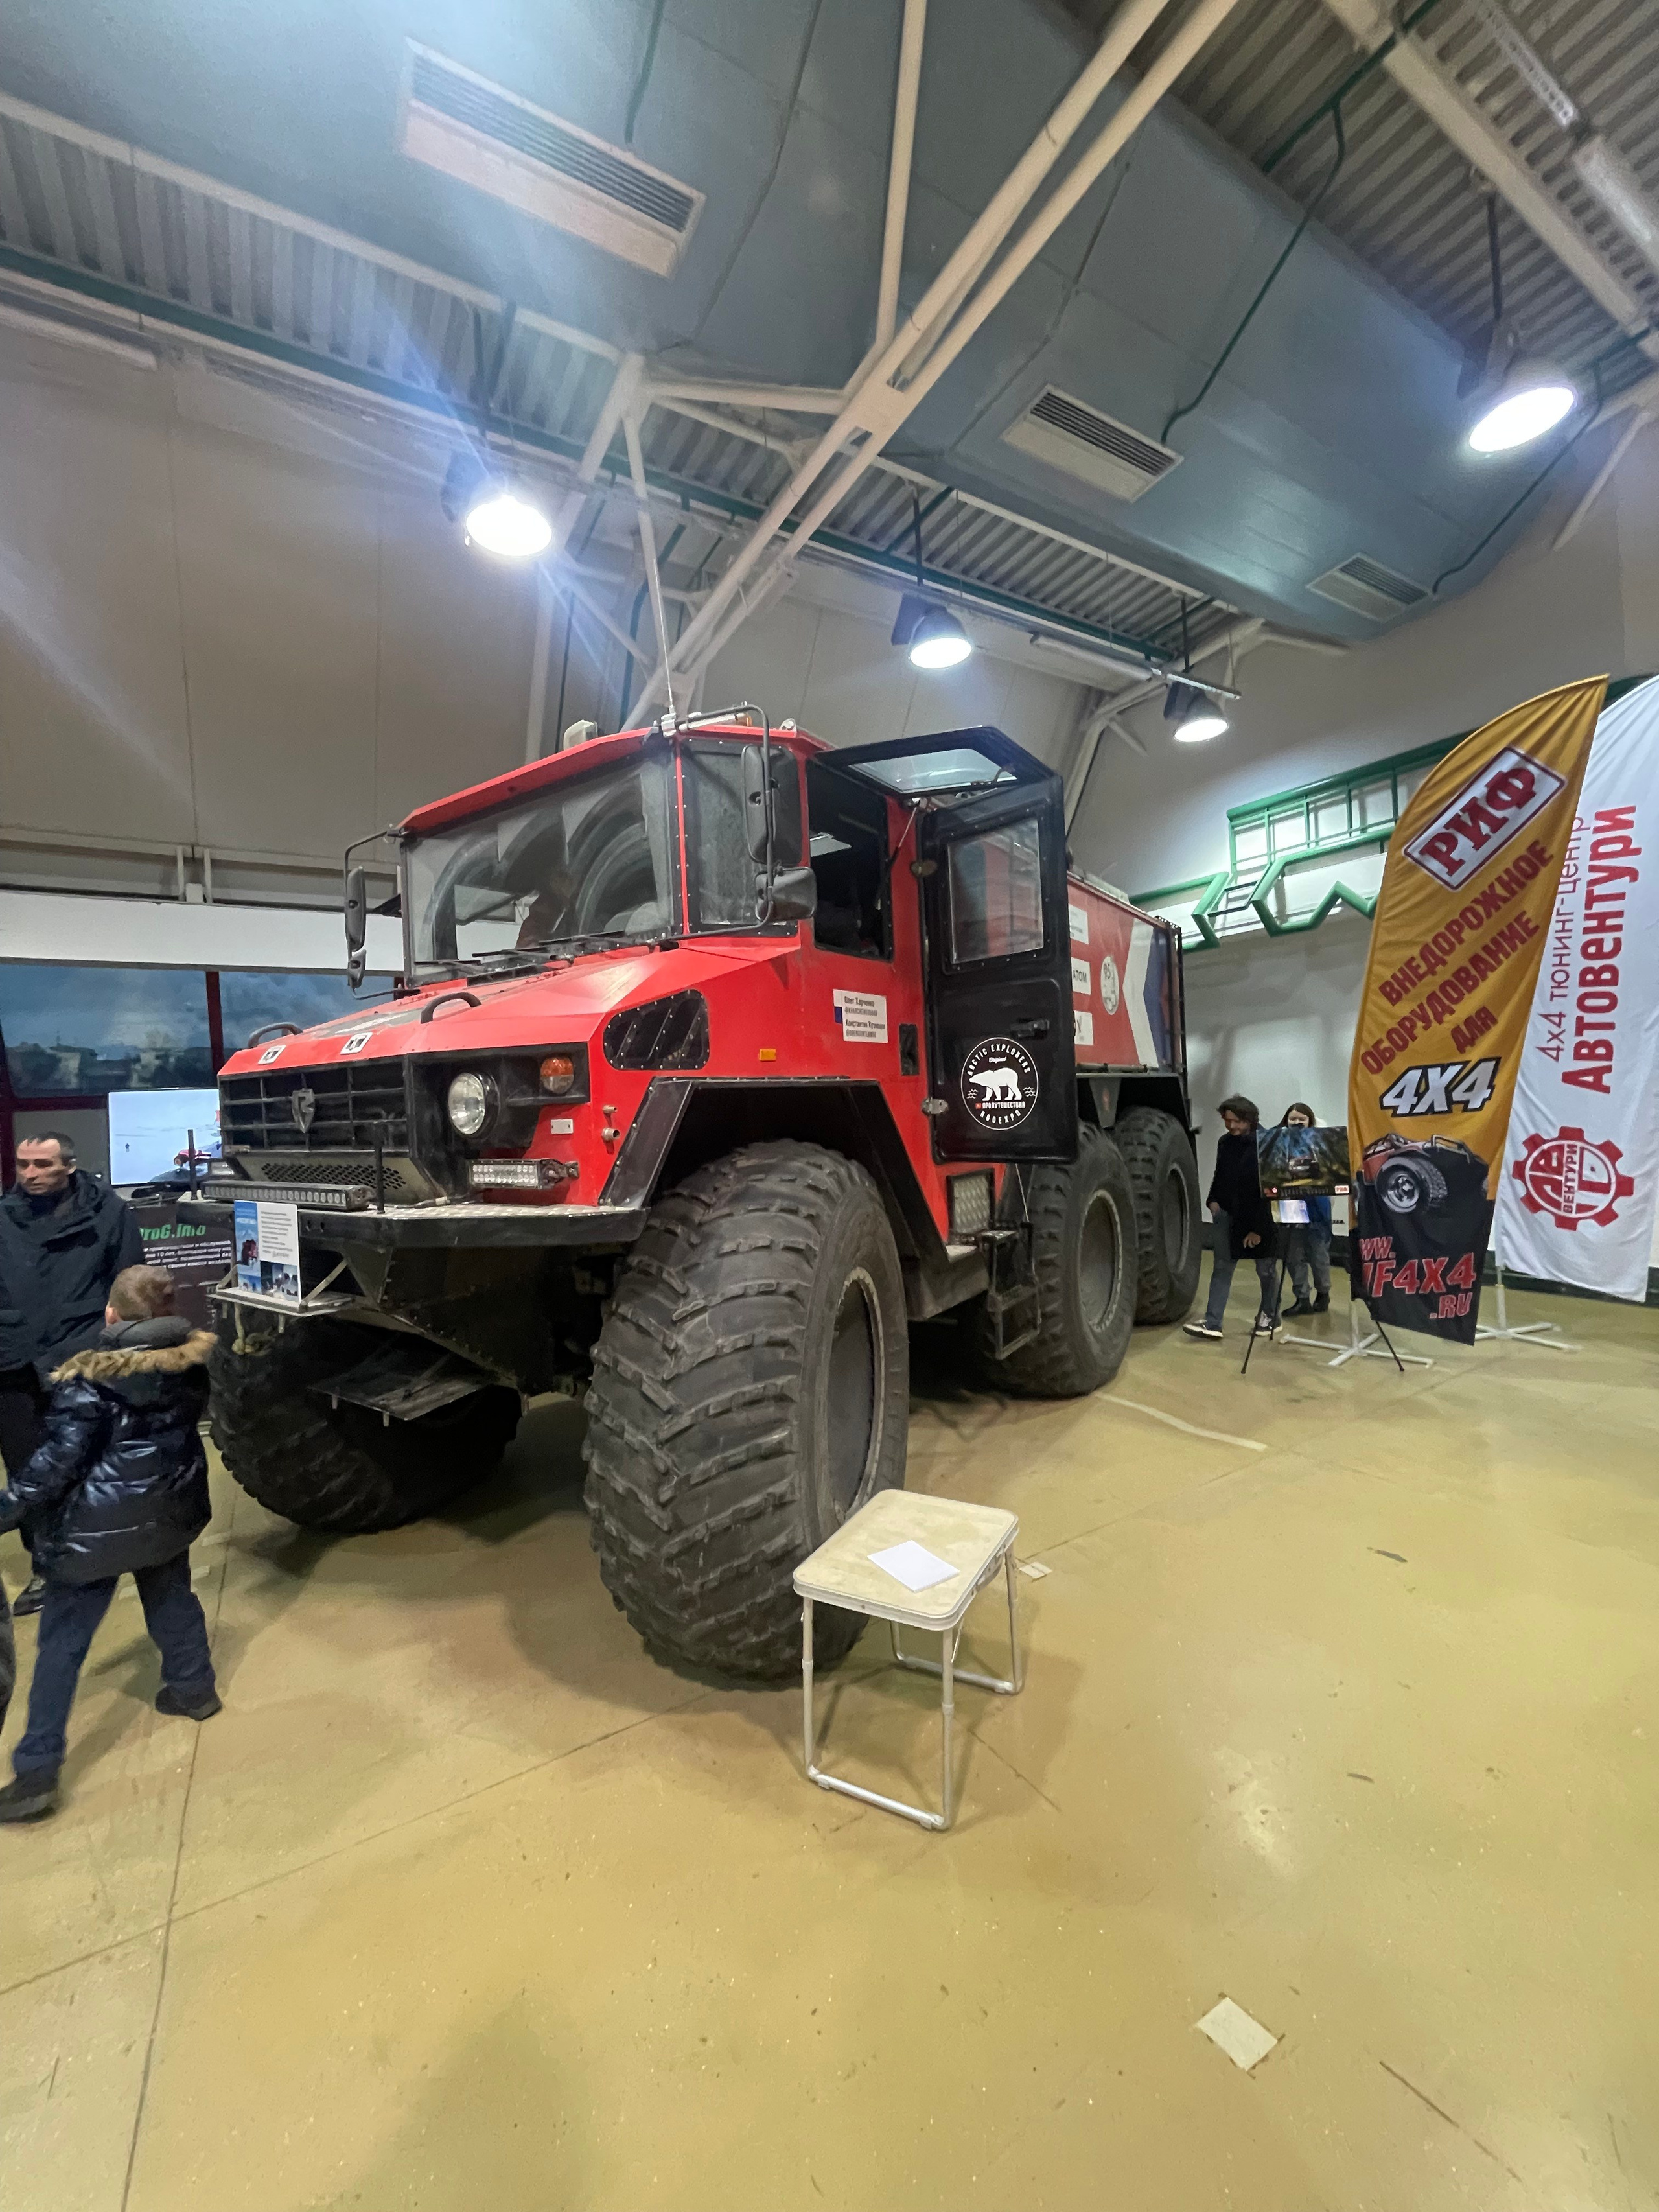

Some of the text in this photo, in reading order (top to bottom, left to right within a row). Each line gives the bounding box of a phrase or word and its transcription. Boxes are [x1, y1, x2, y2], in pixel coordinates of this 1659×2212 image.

[1421, 767, 1538, 877] РИФ
[1378, 839, 1553, 1007] ВНЕДОРОЖНОЕ
[1361, 910, 1540, 1075] ОБОРУДОВАНИЕ
[967, 1043, 1030, 1076] ARCTIC EXPLORERS
[1450, 1006, 1498, 1054] ДЛЯ
[1380, 1056, 1501, 1117] 4X4
[1562, 1143, 1577, 1213] ВЕНТУРИ
